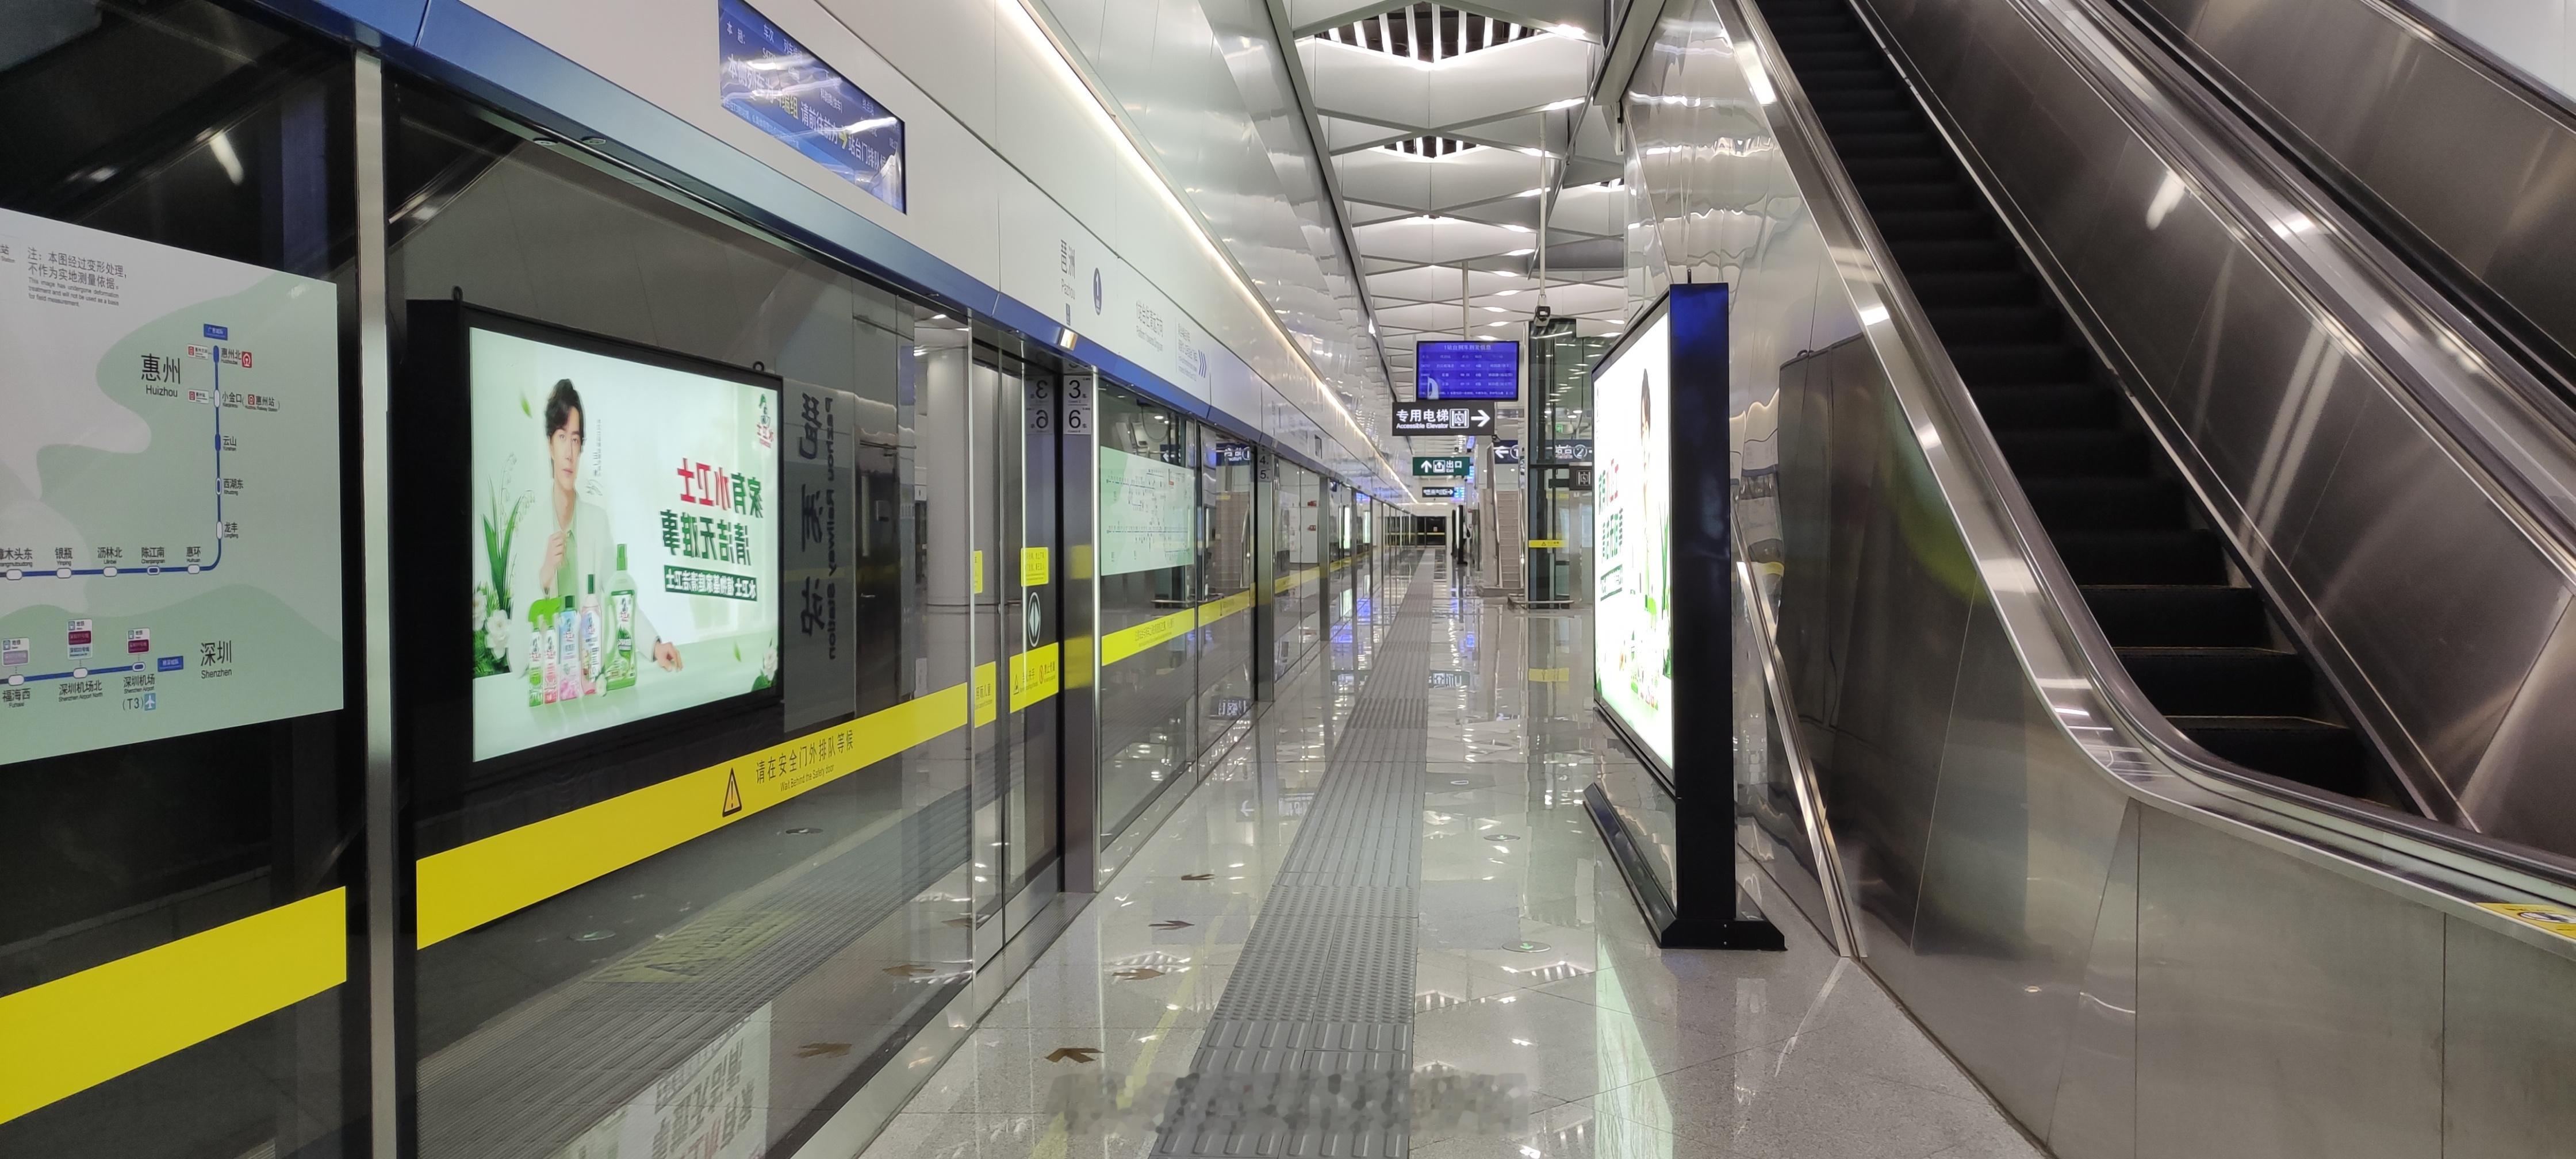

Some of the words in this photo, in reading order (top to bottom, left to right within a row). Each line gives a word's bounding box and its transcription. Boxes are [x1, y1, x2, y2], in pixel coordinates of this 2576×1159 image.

[1061, 239, 1075, 279] 琶洲
[221, 347, 241, 360] 惠州北
[141, 353, 181, 384] 惠州
[145, 385, 178, 398] Huizhou
[1069, 379, 1081, 398] 3
[1068, 409, 1081, 428] 6
[1396, 409, 1449, 423] 专用电梯
[223, 435, 237, 446] 云山
[1577, 448, 1584, 457] 2
[1446, 460, 1462, 469] 出口
[224, 478, 244, 489] 西湖东
[224, 521, 238, 533] 龙丰
[55, 547, 73, 559] 银瓶
[97, 547, 122, 558] 沥林北
[141, 547, 165, 558] 陈江南
[186, 546, 201, 558] 惠环
[200, 640, 232, 666] 深圳
[201, 668, 232, 679] Shenzhen
[2, 688, 31, 703] 福海西
[59, 680, 102, 696] 深圳机场北
[123, 673, 155, 688] 深圳机场
[122, 697, 144, 711] (T3)
[756, 729, 854, 784] 请在安全门外排队等候
